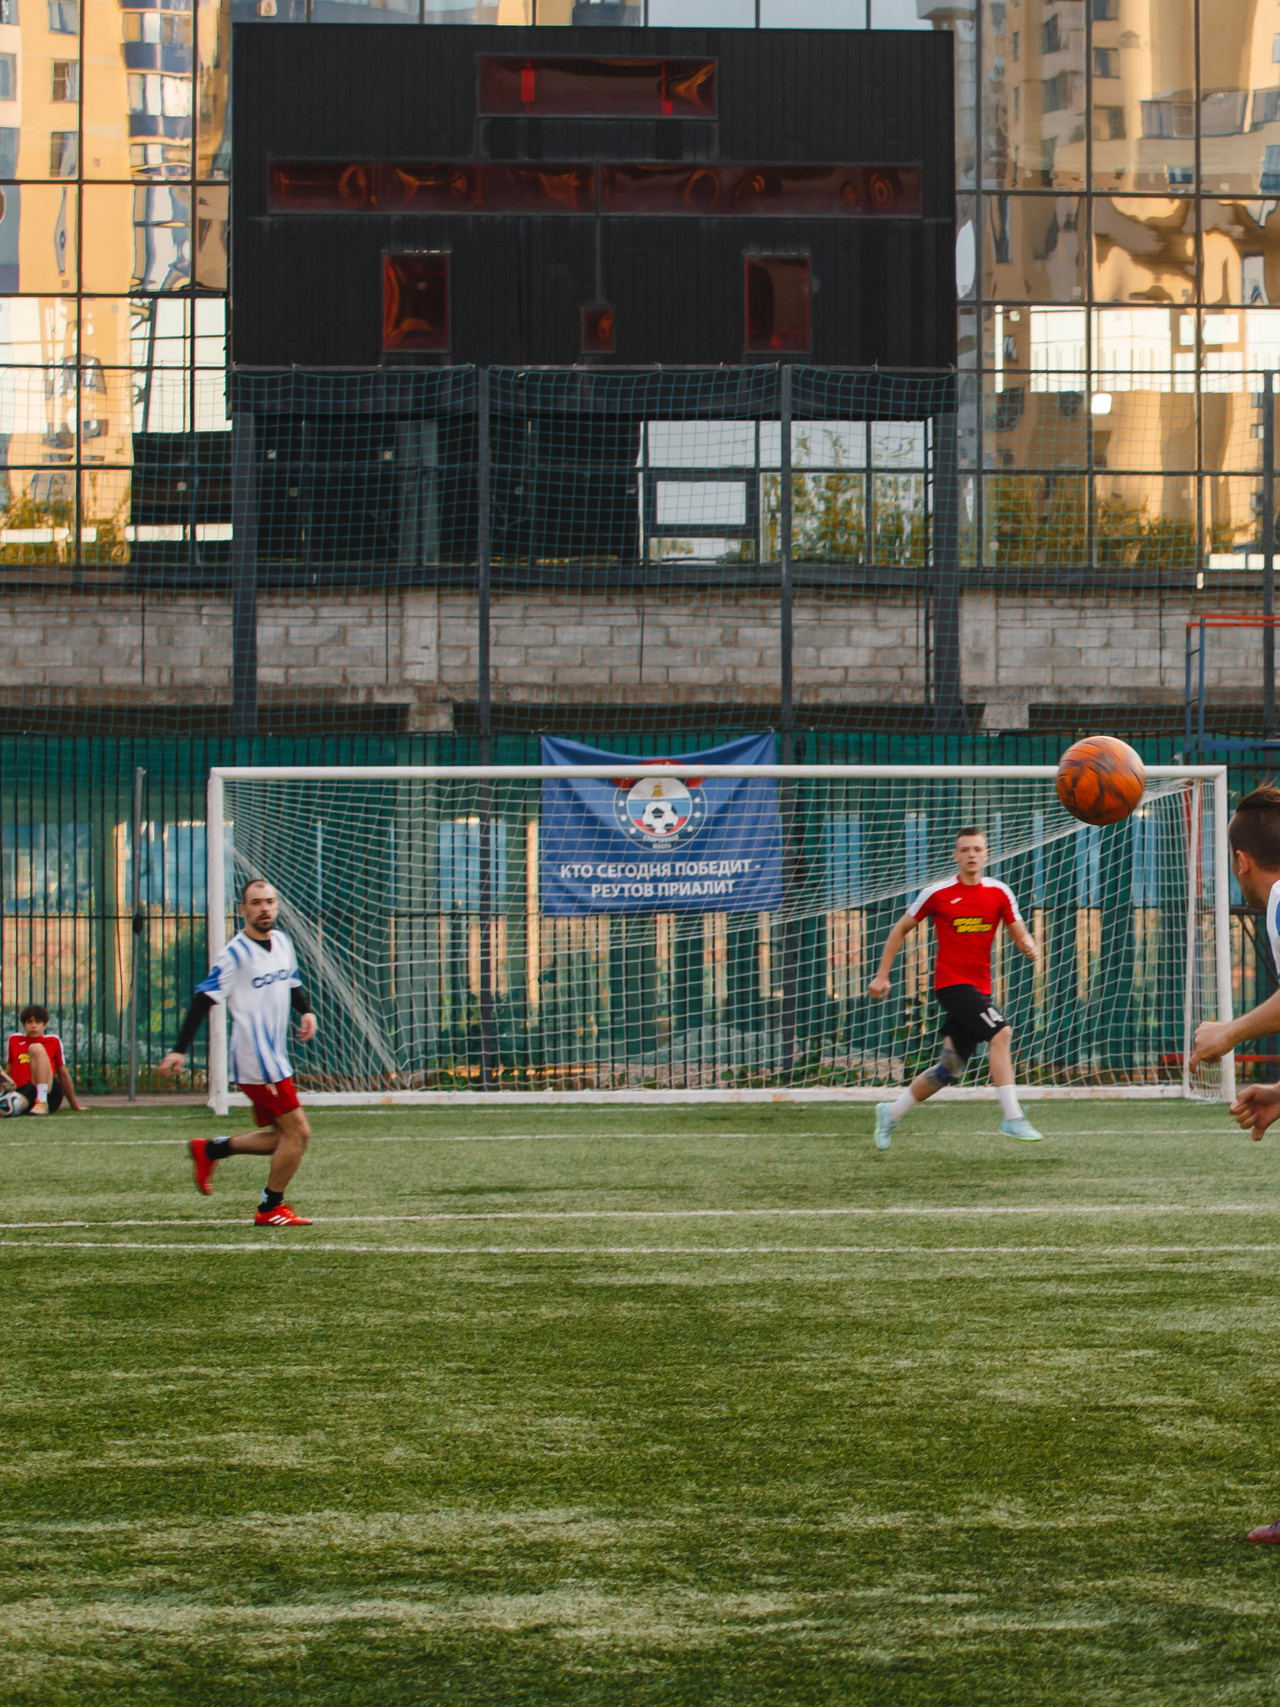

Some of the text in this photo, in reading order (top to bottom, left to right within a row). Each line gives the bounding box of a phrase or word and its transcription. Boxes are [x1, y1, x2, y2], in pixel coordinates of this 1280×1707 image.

[560, 864, 593, 879] КТО
[597, 862, 671, 880] СЕГОДНЯ
[675, 859, 751, 877] ПОБЕДИТ
[591, 880, 735, 898] РЕУТОВ ПРИАЛИТ
